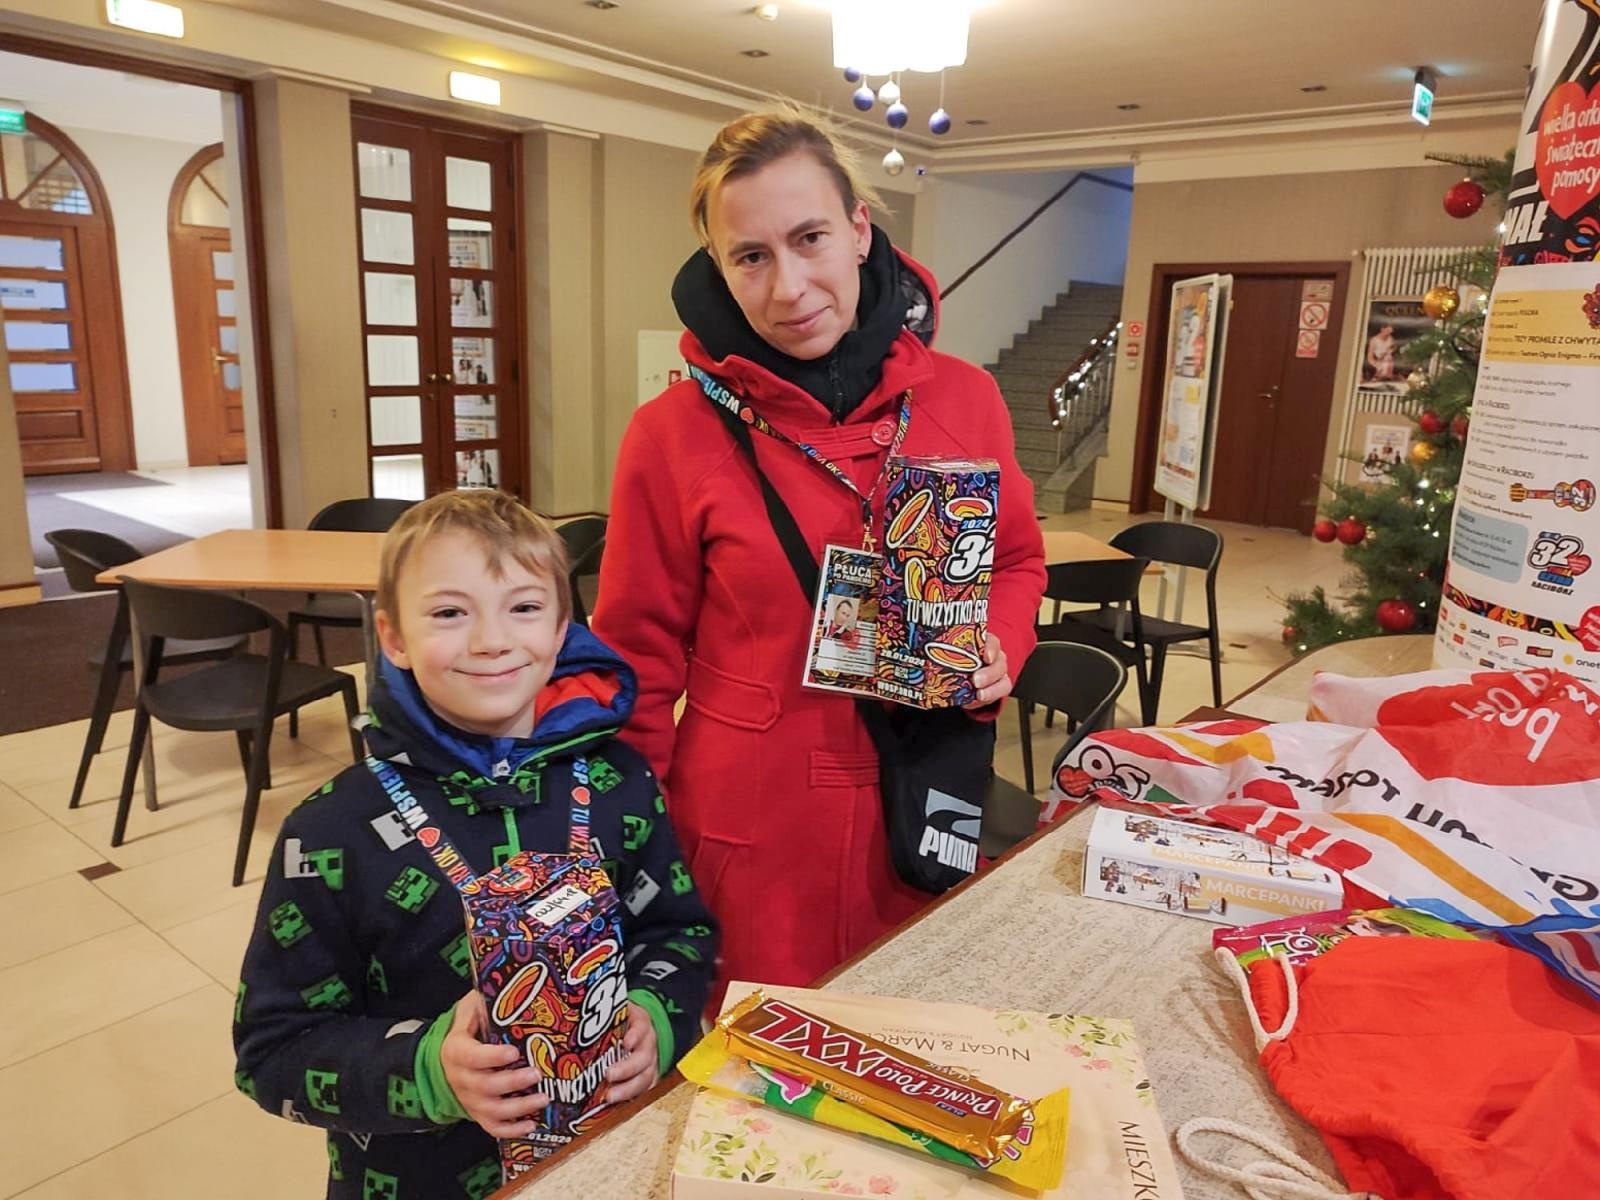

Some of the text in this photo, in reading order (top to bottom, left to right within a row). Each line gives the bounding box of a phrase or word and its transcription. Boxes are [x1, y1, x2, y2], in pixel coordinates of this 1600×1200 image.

[1550, 166, 1600, 197] pomocy
[961, 518, 990, 530] 2024
[1530, 538, 1581, 567] 32
[834, 563, 872, 579] PŁUCA
[906, 599, 920, 623] TU
[921, 600, 973, 627] WSZYSTKO
[571, 808, 591, 824] TU
[919, 825, 978, 874] PUMA
[750, 1001, 887, 1077] XXL
[942, 1040, 953, 1051] &
[960, 1042, 1030, 1062] NUGAT
[875, 1066, 926, 1096] POLO
[926, 1083, 997, 1115] PRINCE
[1118, 1121, 1160, 1200] MIESZK
